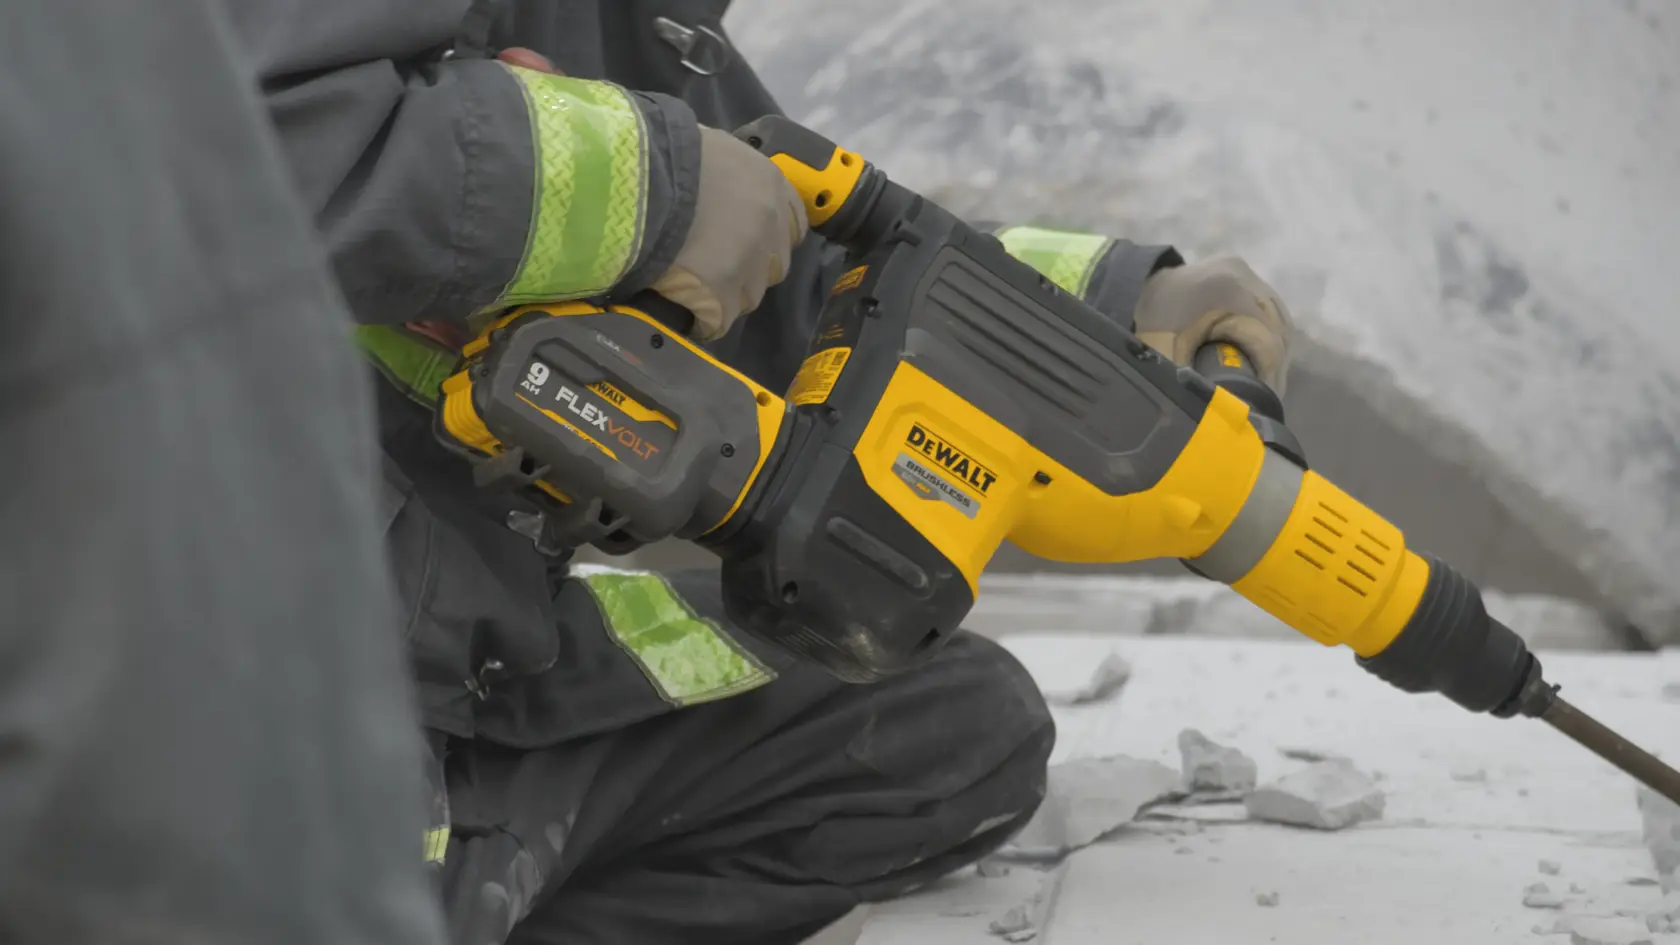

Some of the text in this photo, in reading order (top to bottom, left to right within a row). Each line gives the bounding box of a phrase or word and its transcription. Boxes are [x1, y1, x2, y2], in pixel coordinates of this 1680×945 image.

[527, 362, 550, 387] 9
[555, 385, 660, 461] FLEXVOLT
[906, 460, 971, 508] BRUSHLESS
